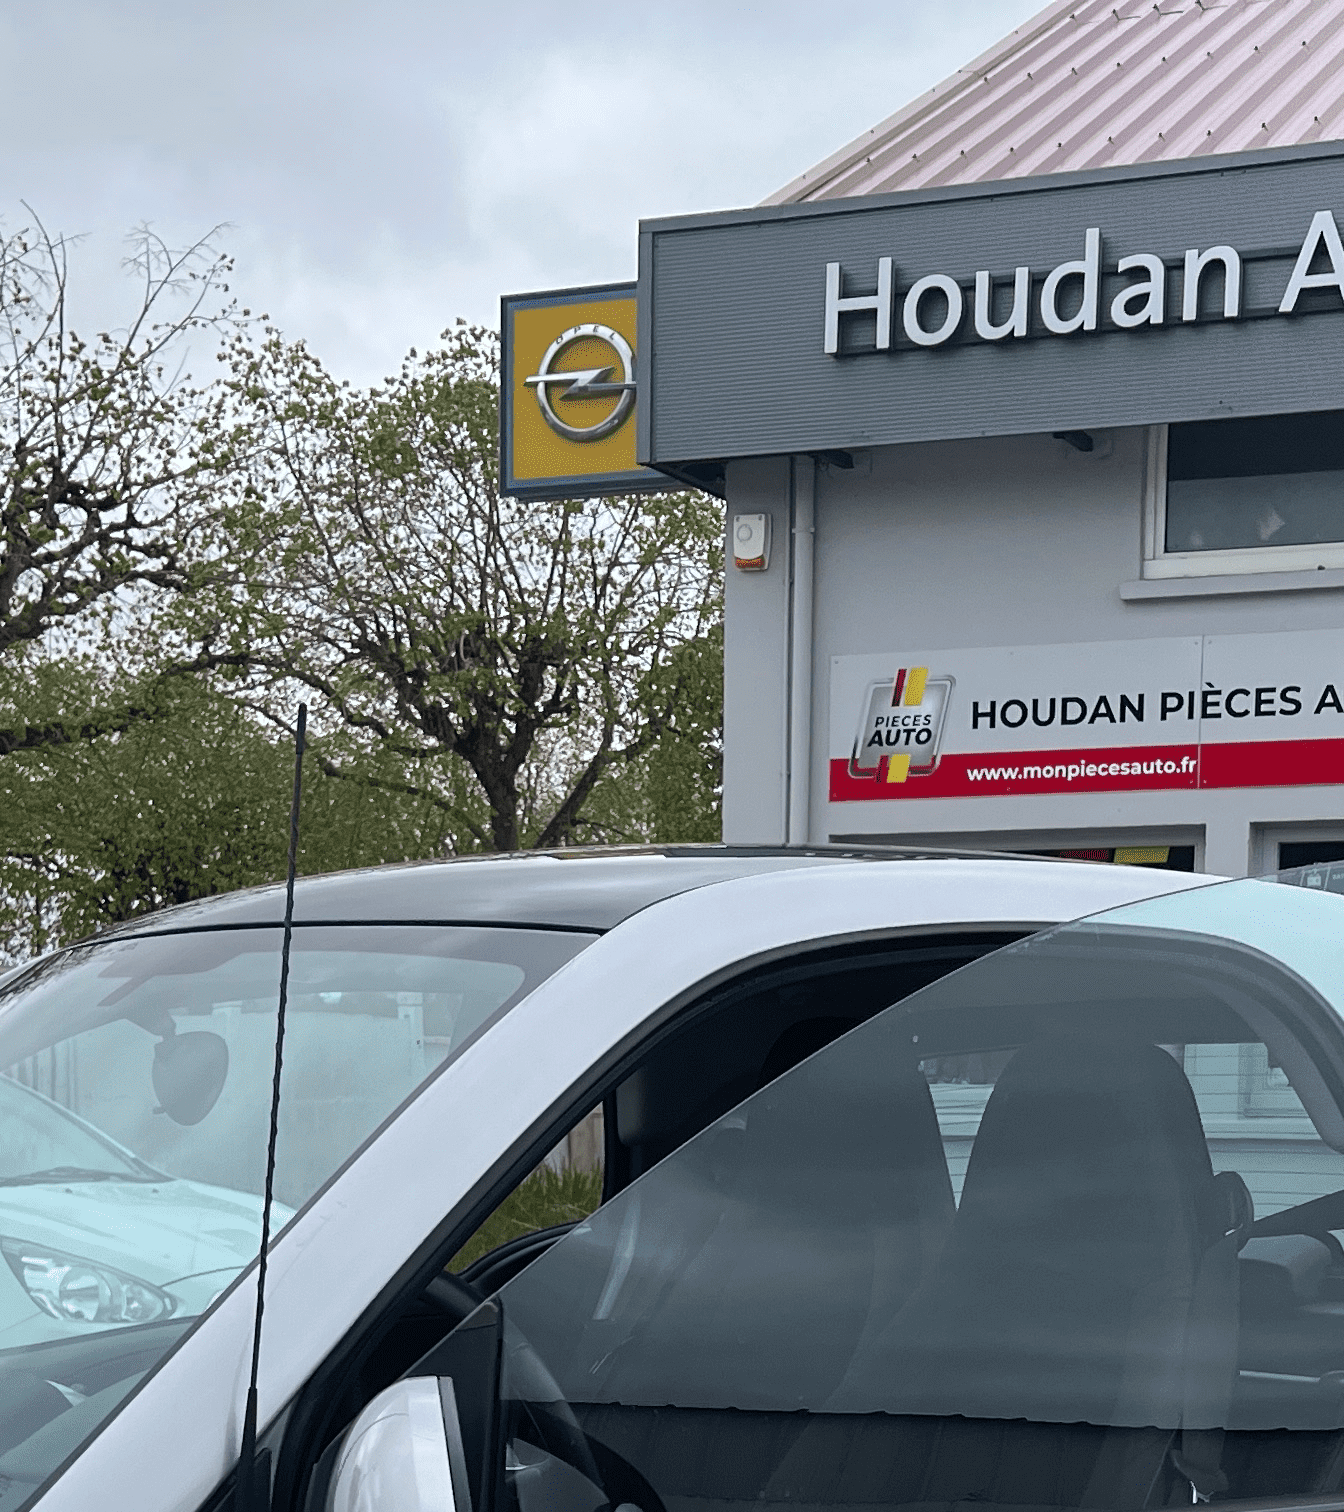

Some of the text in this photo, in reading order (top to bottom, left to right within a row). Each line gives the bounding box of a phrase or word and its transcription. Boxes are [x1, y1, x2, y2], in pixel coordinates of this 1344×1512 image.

[824, 226, 1244, 356] Houdan
[555, 323, 617, 346] OPEL
[972, 695, 1147, 730] HOUDAN
[1160, 682, 1303, 722] PIÈCES
[874, 714, 933, 730] PIECES
[867, 727, 933, 748] AUTO
[966, 755, 1198, 783] www.monpiecesauto.fr
